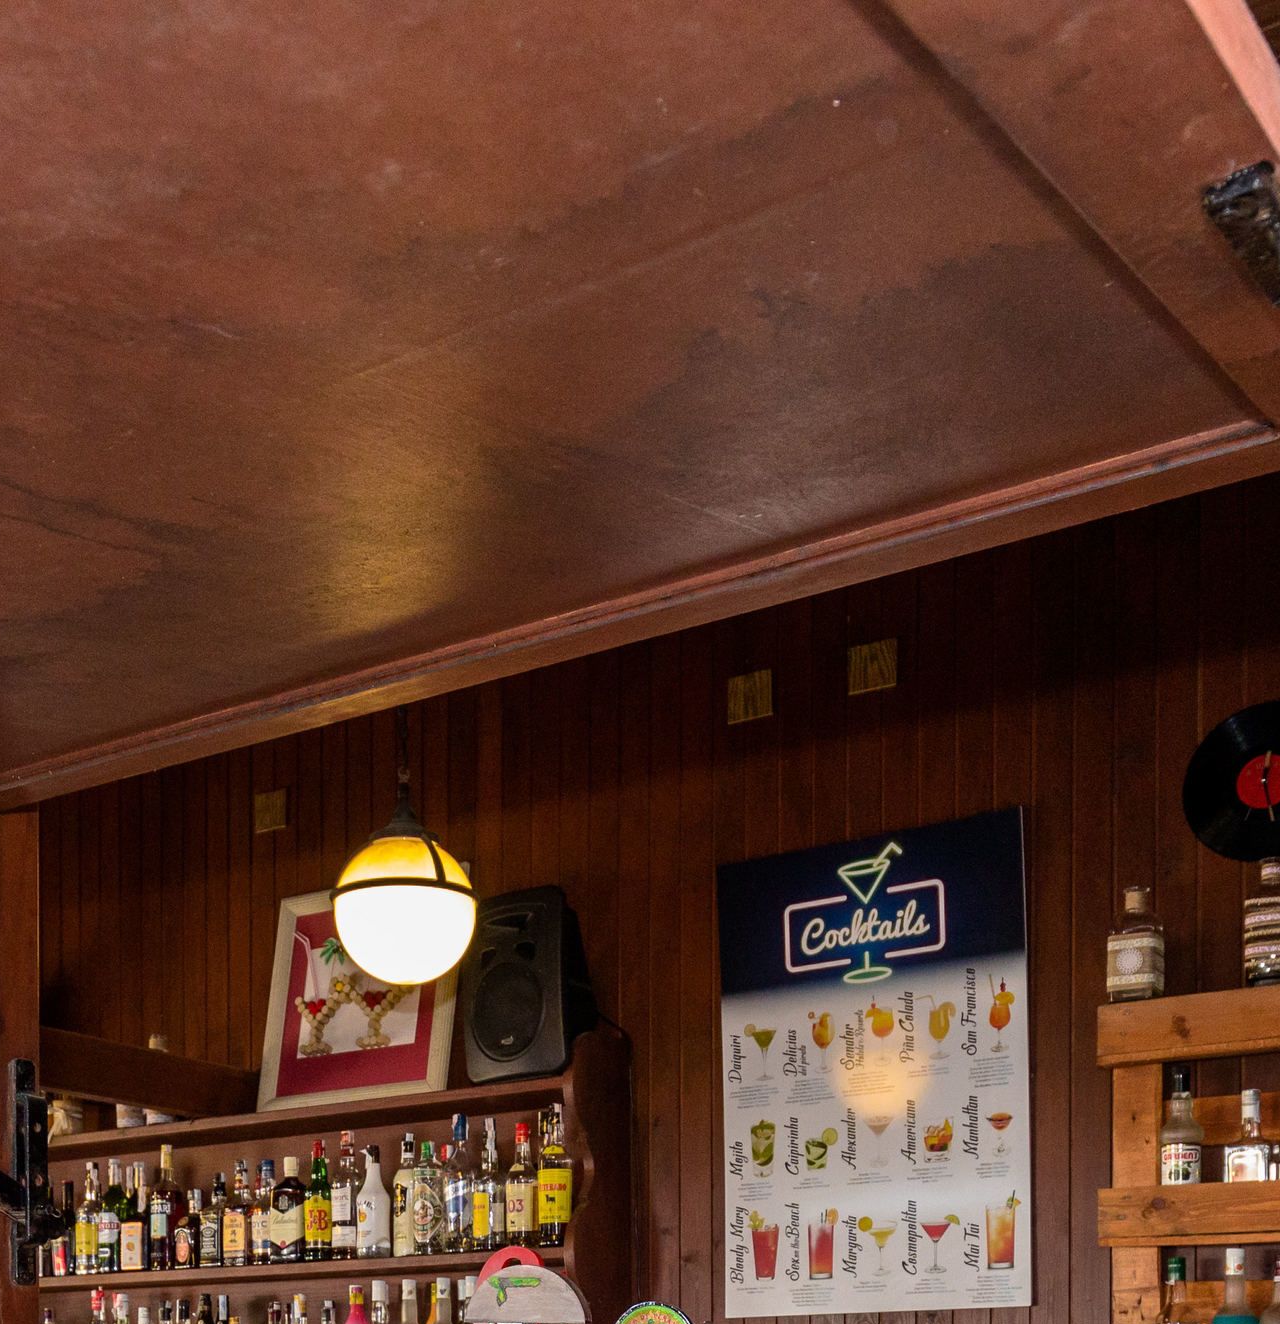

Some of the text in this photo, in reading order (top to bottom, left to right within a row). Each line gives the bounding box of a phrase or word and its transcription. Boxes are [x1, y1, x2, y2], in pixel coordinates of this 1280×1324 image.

[801, 899, 931, 956] Cocktails
[897, 991, 915, 1063] Piña Colada
[961, 967, 978, 1056] San Francisco
[728, 1034, 747, 1084] Daiquiri
[783, 1029, 798, 1077] Delicias
[839, 1023, 855, 1070] Senator
[784, 1116, 804, 1176] Caipirinha
[841, 1107, 857, 1170] Alexander
[901, 1099, 917, 1165] Americano
[961, 1095, 979, 1160] Manhattan
[729, 1140, 749, 1180] Mojito
[730, 1206, 749, 1284] Bloody Mary
[785, 1203, 800, 1239] Beach
[842, 1215, 863, 1278] Margarita
[901, 1200, 923, 1275] Cosmopolitan
[963, 1223, 980, 1272] Mai Tai
[785, 1257, 800, 1282] Sex
